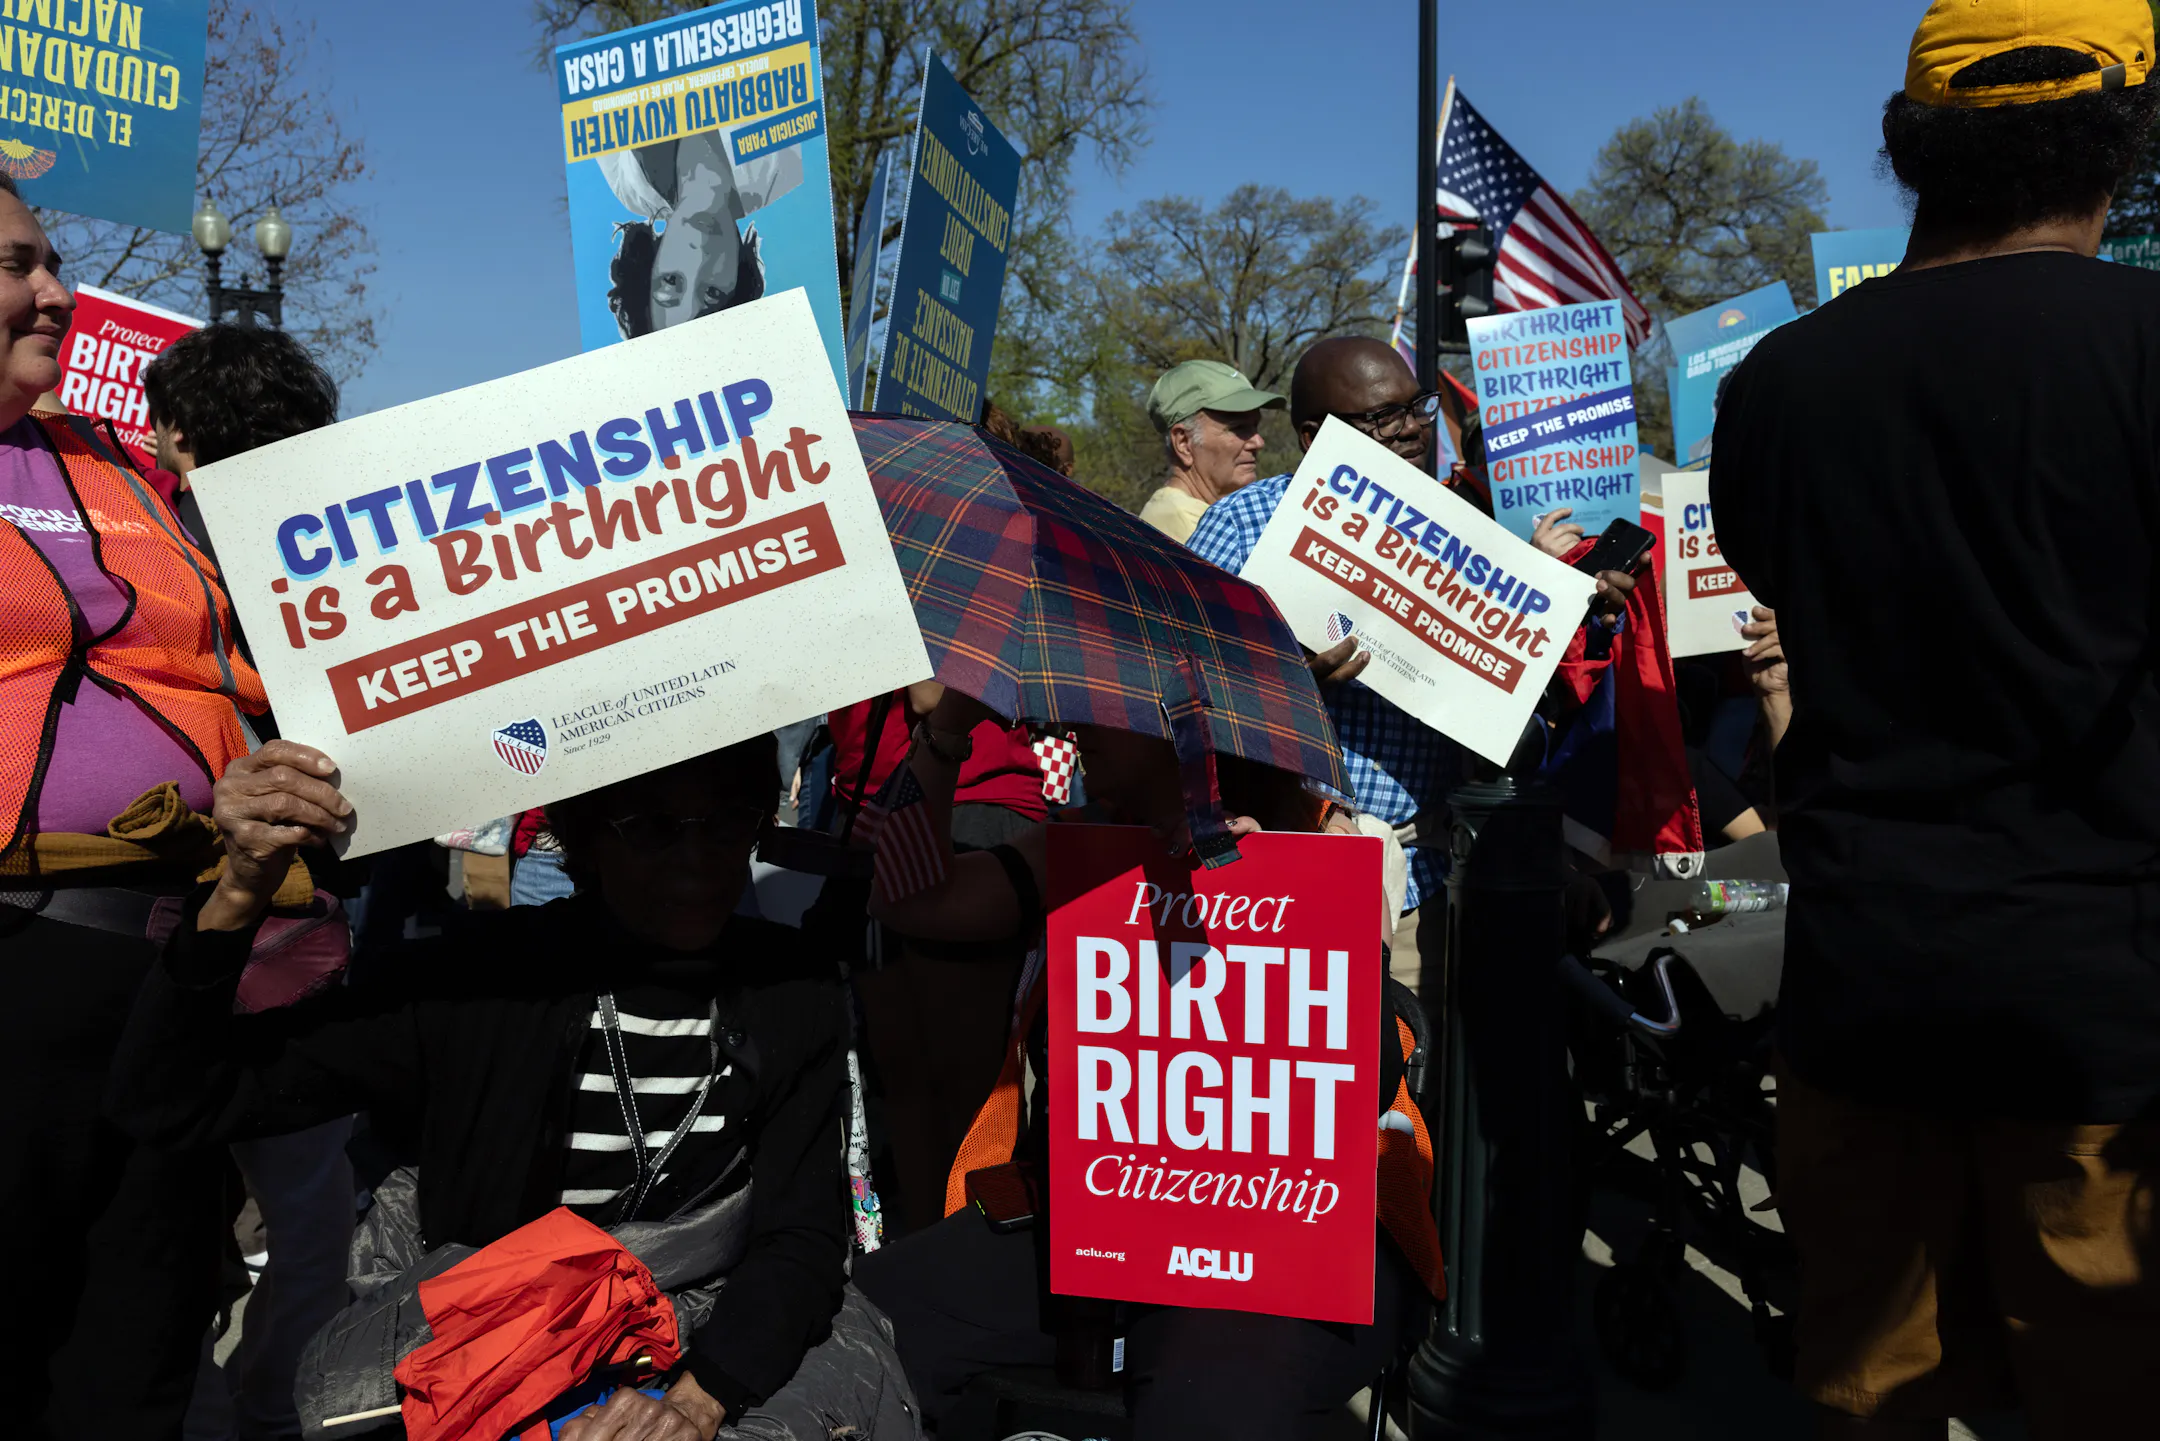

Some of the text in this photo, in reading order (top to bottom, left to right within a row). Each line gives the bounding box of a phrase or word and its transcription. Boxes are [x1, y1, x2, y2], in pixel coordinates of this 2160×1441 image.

[0, 24, 180, 111] CIUDADAN
[564, 0, 803, 95] REGRESENLA A CASA
[571, 63, 808, 158] RABBIATU KUYATEH
[639, 86, 650, 101] LA
[651, 84, 660, 98] DE
[663, 79, 685, 95] PILAR
[0, 85, 133, 147] EL DERECH
[737, 110, 818, 155] JUSTICIA PARA
[919, 125, 1010, 253] CONSTITUTIONNEL
[940, 211, 975, 277] DROIT
[2099, 237, 2160, 261] Maryla
[98, 319, 166, 351] Protect
[912, 287, 975, 370] NAISSANCE
[1477, 333, 1622, 371] CITIZENSHIP
[68, 331, 158, 387] BIRT
[890, 331, 910, 384] DE
[1483, 360, 1624, 398] BIRTHRIGHT
[60, 369, 149, 427] RIGH
[1485, 391, 1601, 426] CITIZE
[1487, 428, 1530, 452] KEEP
[1532, 416, 1565, 436] THE
[1566, 396, 1634, 426] PROMISE
[276, 377, 772, 580] CITIZENSHIP
[1493, 444, 1635, 482] CITIZENSHIP
[1499, 473, 1635, 510] BIRTHRIGHT
[271, 426, 831, 650] is a Birthright
[1328, 464, 1551, 617] CITIZENSHIP
[1678, 527, 1700, 560] is
[1302, 478, 1339, 522] is
[1341, 512, 1369, 542] a
[1374, 525, 1552, 658] Birthright
[1696, 571, 1737, 592] KEEP
[356, 526, 818, 711] KEEP THE PROMISE
[1305, 540, 1512, 682] KEEP THE PROMISE
[1355, 628, 1384, 650] LEAGUE
[1389, 652, 1416, 674] UNITED
[1413, 668, 1437, 687] LATIN
[1358, 640, 1417, 684] MERICAN CITIZENS
[552, 659, 737, 729] LEAGUE of UNITED LATIN
[559, 686, 706, 743] AMERICAN CITIZENS
[497, 734, 543, 755] LULAC
[563, 732, 611, 756] Since 1929
[1124, 881, 1295, 934] Protect
[1075, 935, 1350, 1050] BIRTH
[1076, 1044, 1356, 1160] RIGHT
[1084, 1154, 1340, 1224] Citizenship
[1075, 1245, 1254, 1282] aclu.org ACLU
